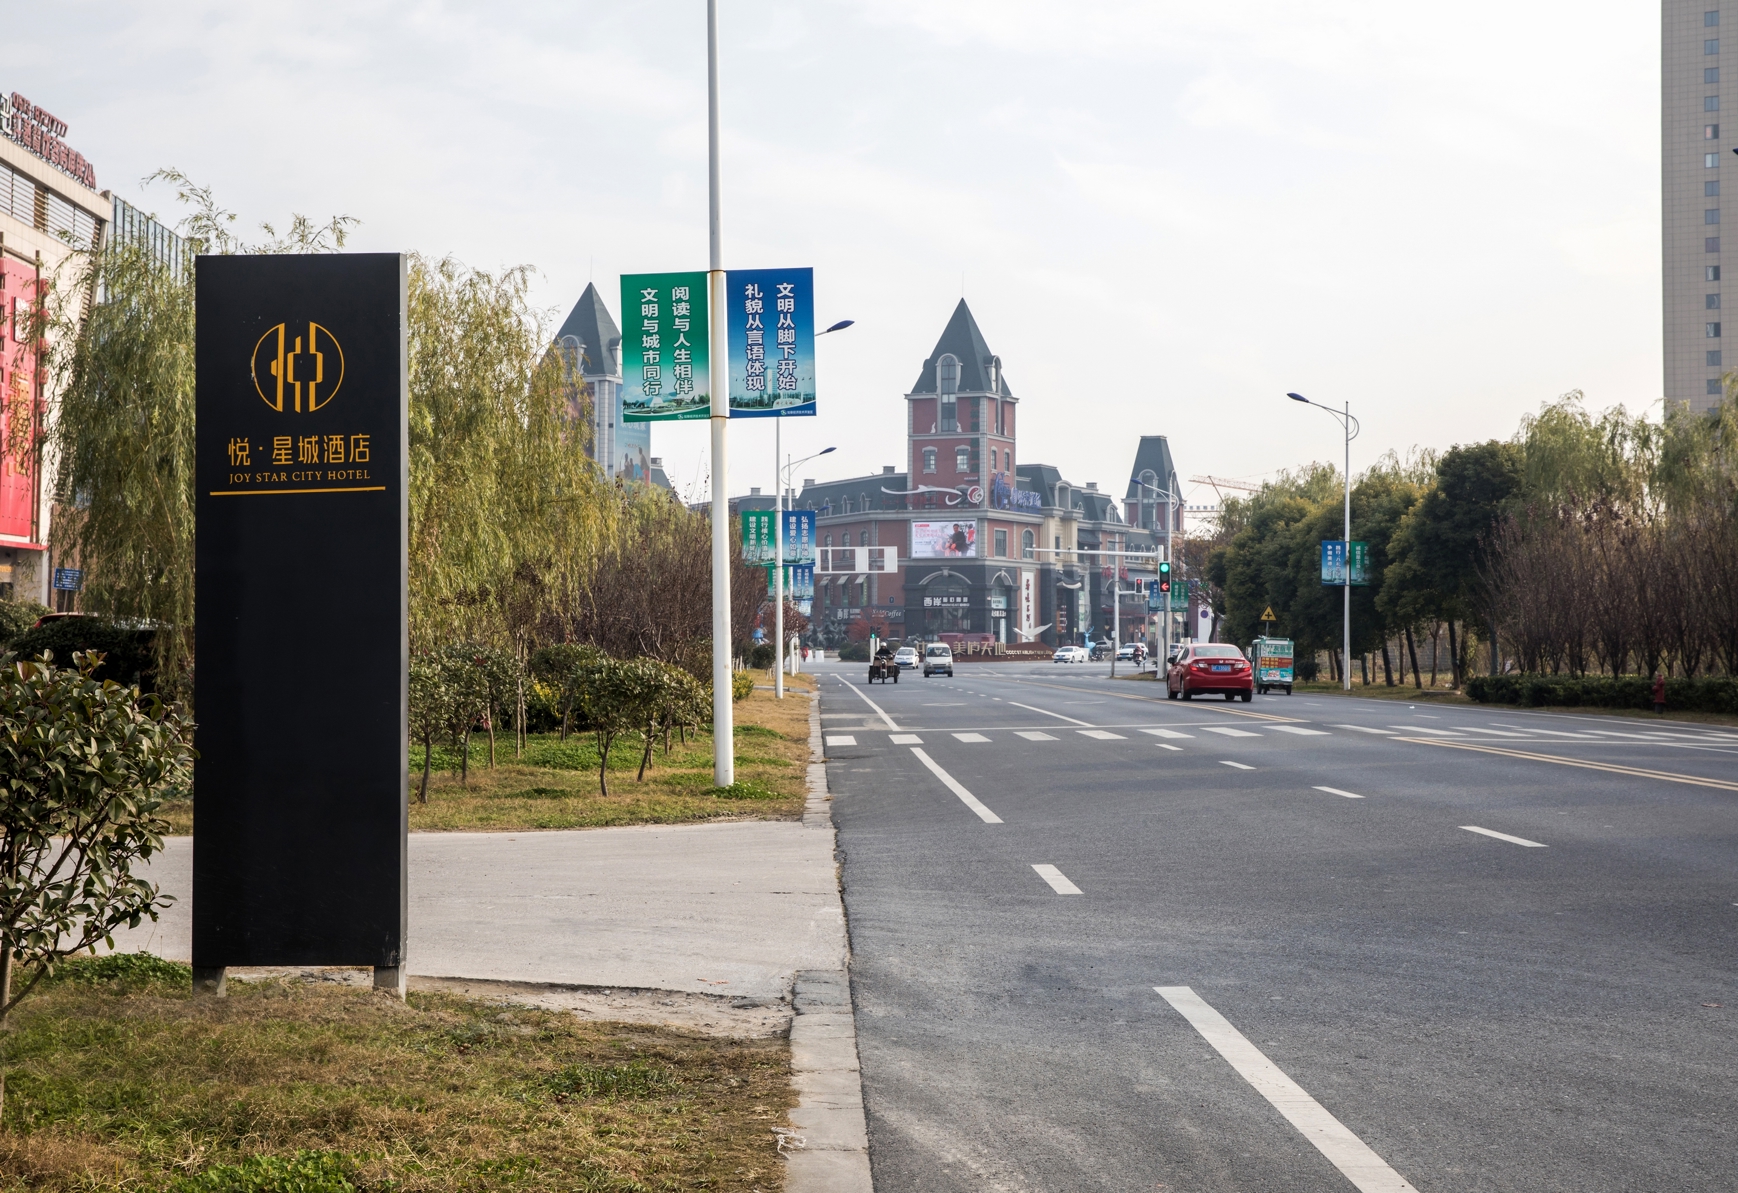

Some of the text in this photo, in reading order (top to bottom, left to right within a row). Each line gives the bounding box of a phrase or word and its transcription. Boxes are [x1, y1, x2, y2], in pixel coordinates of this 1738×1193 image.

[640, 287, 662, 396] 文明与城市同行
[672, 286, 693, 395] 阅读与人生相伴
[745, 283, 766, 391] 礼貌从言语体现
[776, 282, 797, 391] 文明从脚下开始
[228, 433, 371, 466] 悦·星城酒店
[229, 470, 371, 484] JOY STAR CITY HOTEL
